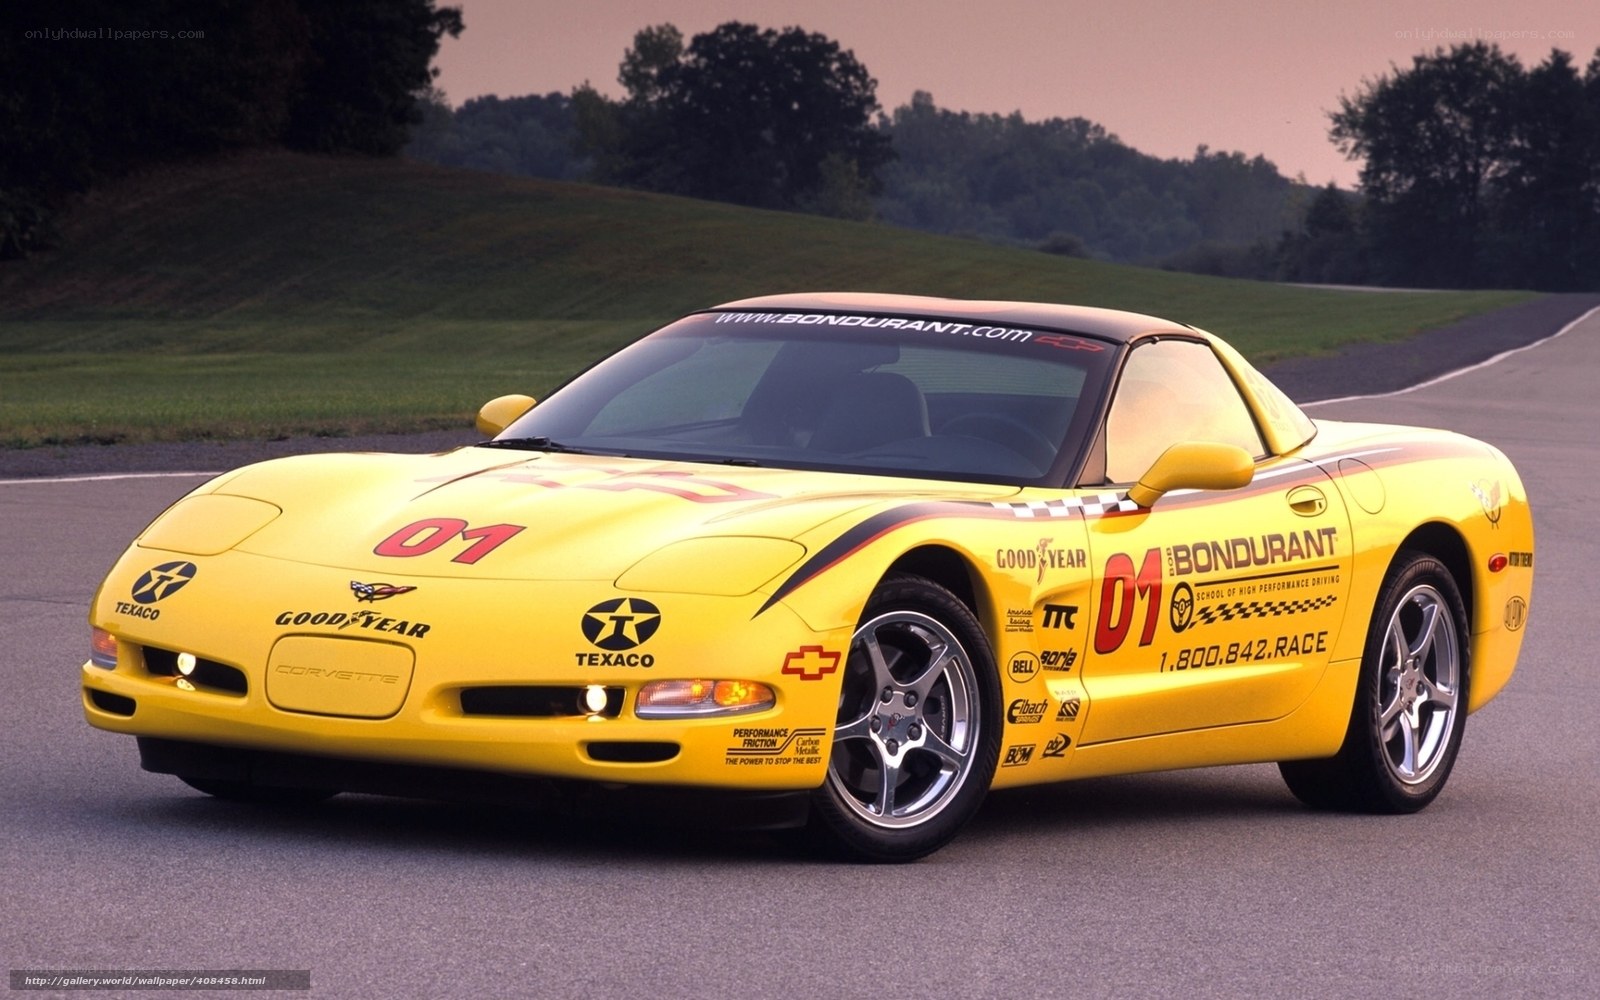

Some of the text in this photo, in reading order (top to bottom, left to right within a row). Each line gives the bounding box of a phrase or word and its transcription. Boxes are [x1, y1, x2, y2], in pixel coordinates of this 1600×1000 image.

[373, 518, 527, 565] 01
[1172, 527, 1337, 576] BONDURANT
[1196, 575, 1340, 601] SCHOOL OF HIGH PERFORMANCE DRIVING
[115, 601, 160, 621] TEXACO
[1094, 547, 1162, 655] 01
[575, 653, 655, 668] TEXACO
[1160, 631, 1329, 673] 1.800.842.RACE
[275, 664, 400, 684] CORVETTE
[1012, 660, 1034, 674] BELL
[733, 728, 788, 738] PERFORMANCE
[742, 738, 777, 748] FRICTION
[796, 737, 820, 746] Carbon
[725, 756, 822, 765] THE POWER TO STOP THE BEST
